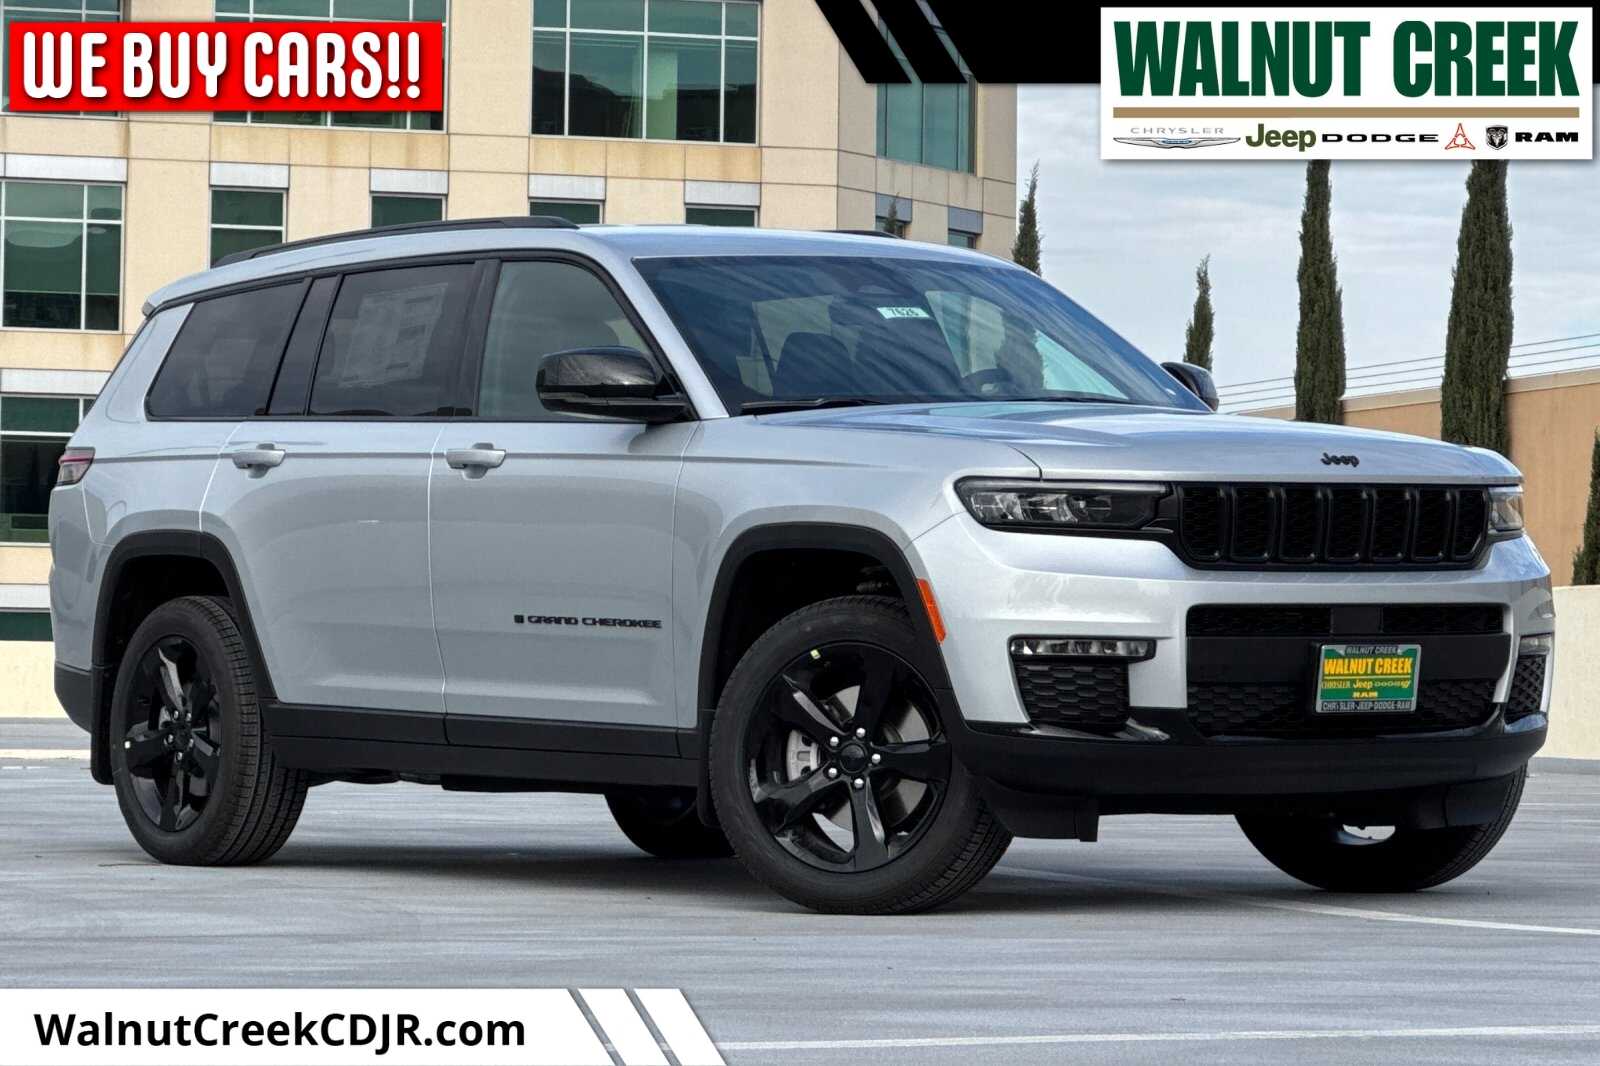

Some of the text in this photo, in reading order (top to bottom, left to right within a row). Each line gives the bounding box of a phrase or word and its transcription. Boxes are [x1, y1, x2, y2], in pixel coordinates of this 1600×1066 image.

[1320, 452, 1360, 468] Jeep
[527, 615, 662, 629] GRAND CHEROKEE
[1346, 646, 1398, 655] WALNUT CREEK
[1324, 658, 1412, 674] WALNUT CREEK
[1353, 679, 1373, 689] Jeep
